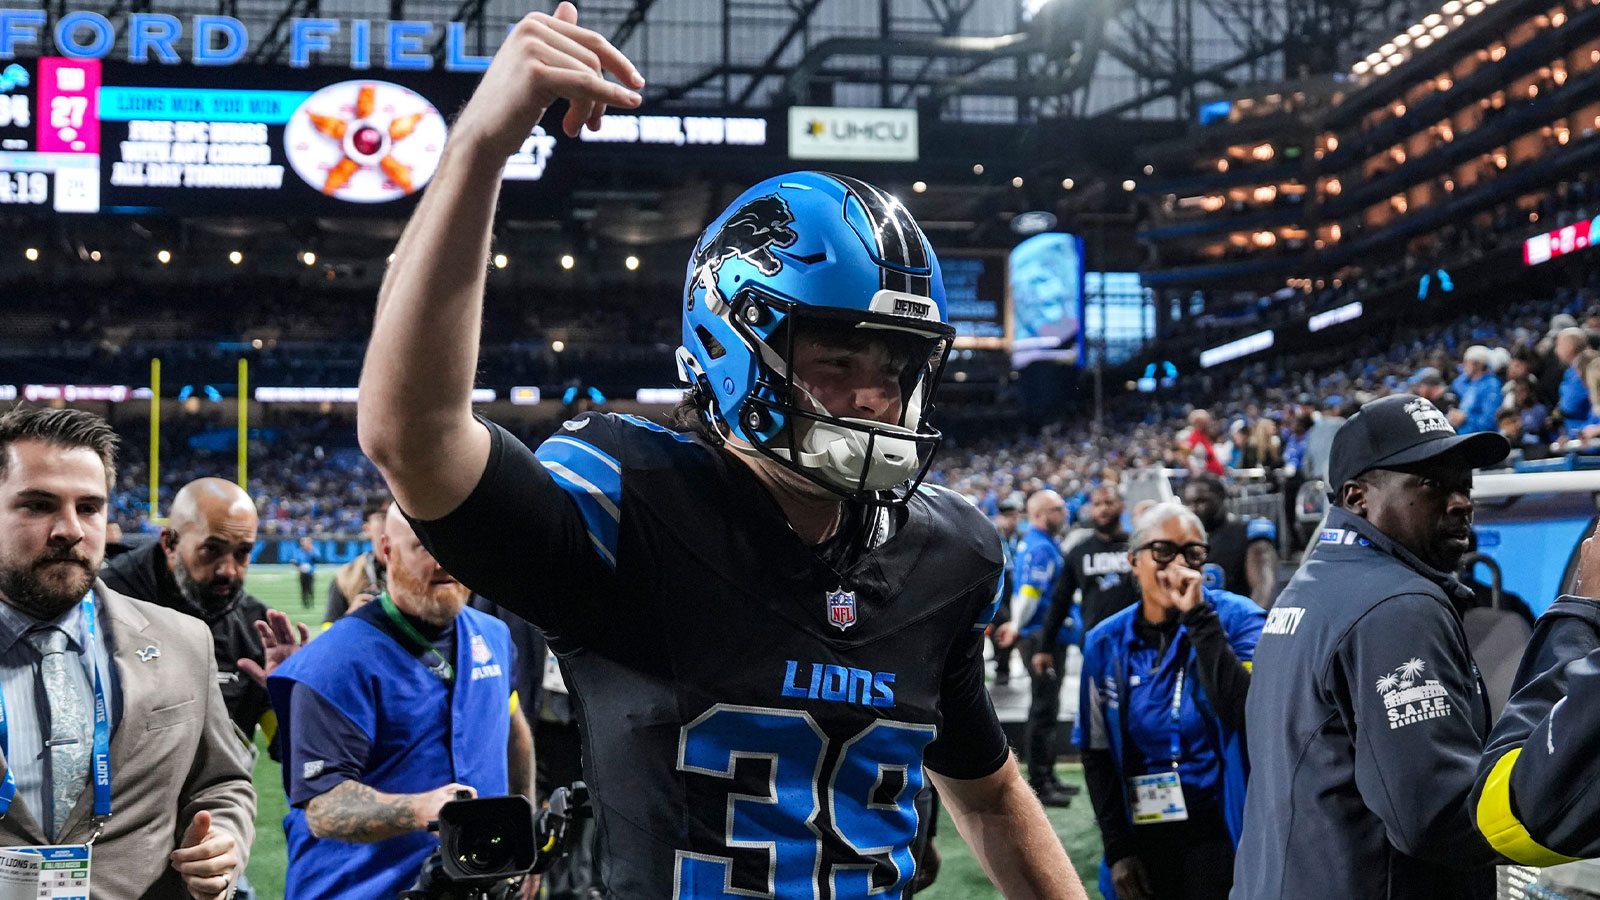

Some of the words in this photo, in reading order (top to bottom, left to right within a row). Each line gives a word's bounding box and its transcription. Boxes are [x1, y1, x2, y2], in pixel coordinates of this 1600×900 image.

[0, 9, 249, 65] FORD
[289, 18, 495, 72] FIEL
[51, 96, 88, 128] 27
[894, 299, 931, 316] DETROIT
[1083, 552, 1131, 576] LIONS
[832, 607, 853, 622] NFL
[781, 660, 897, 708] LIONS
[95, 692, 106, 723] LIONS
[1387, 697, 1451, 722] S.A.F.E.
[1390, 708, 1451, 730] MANAGEMENT
[96, 754, 109, 786] LIONS
[673, 703, 937, 900] 39
[6, 857, 29, 869] LIONS
